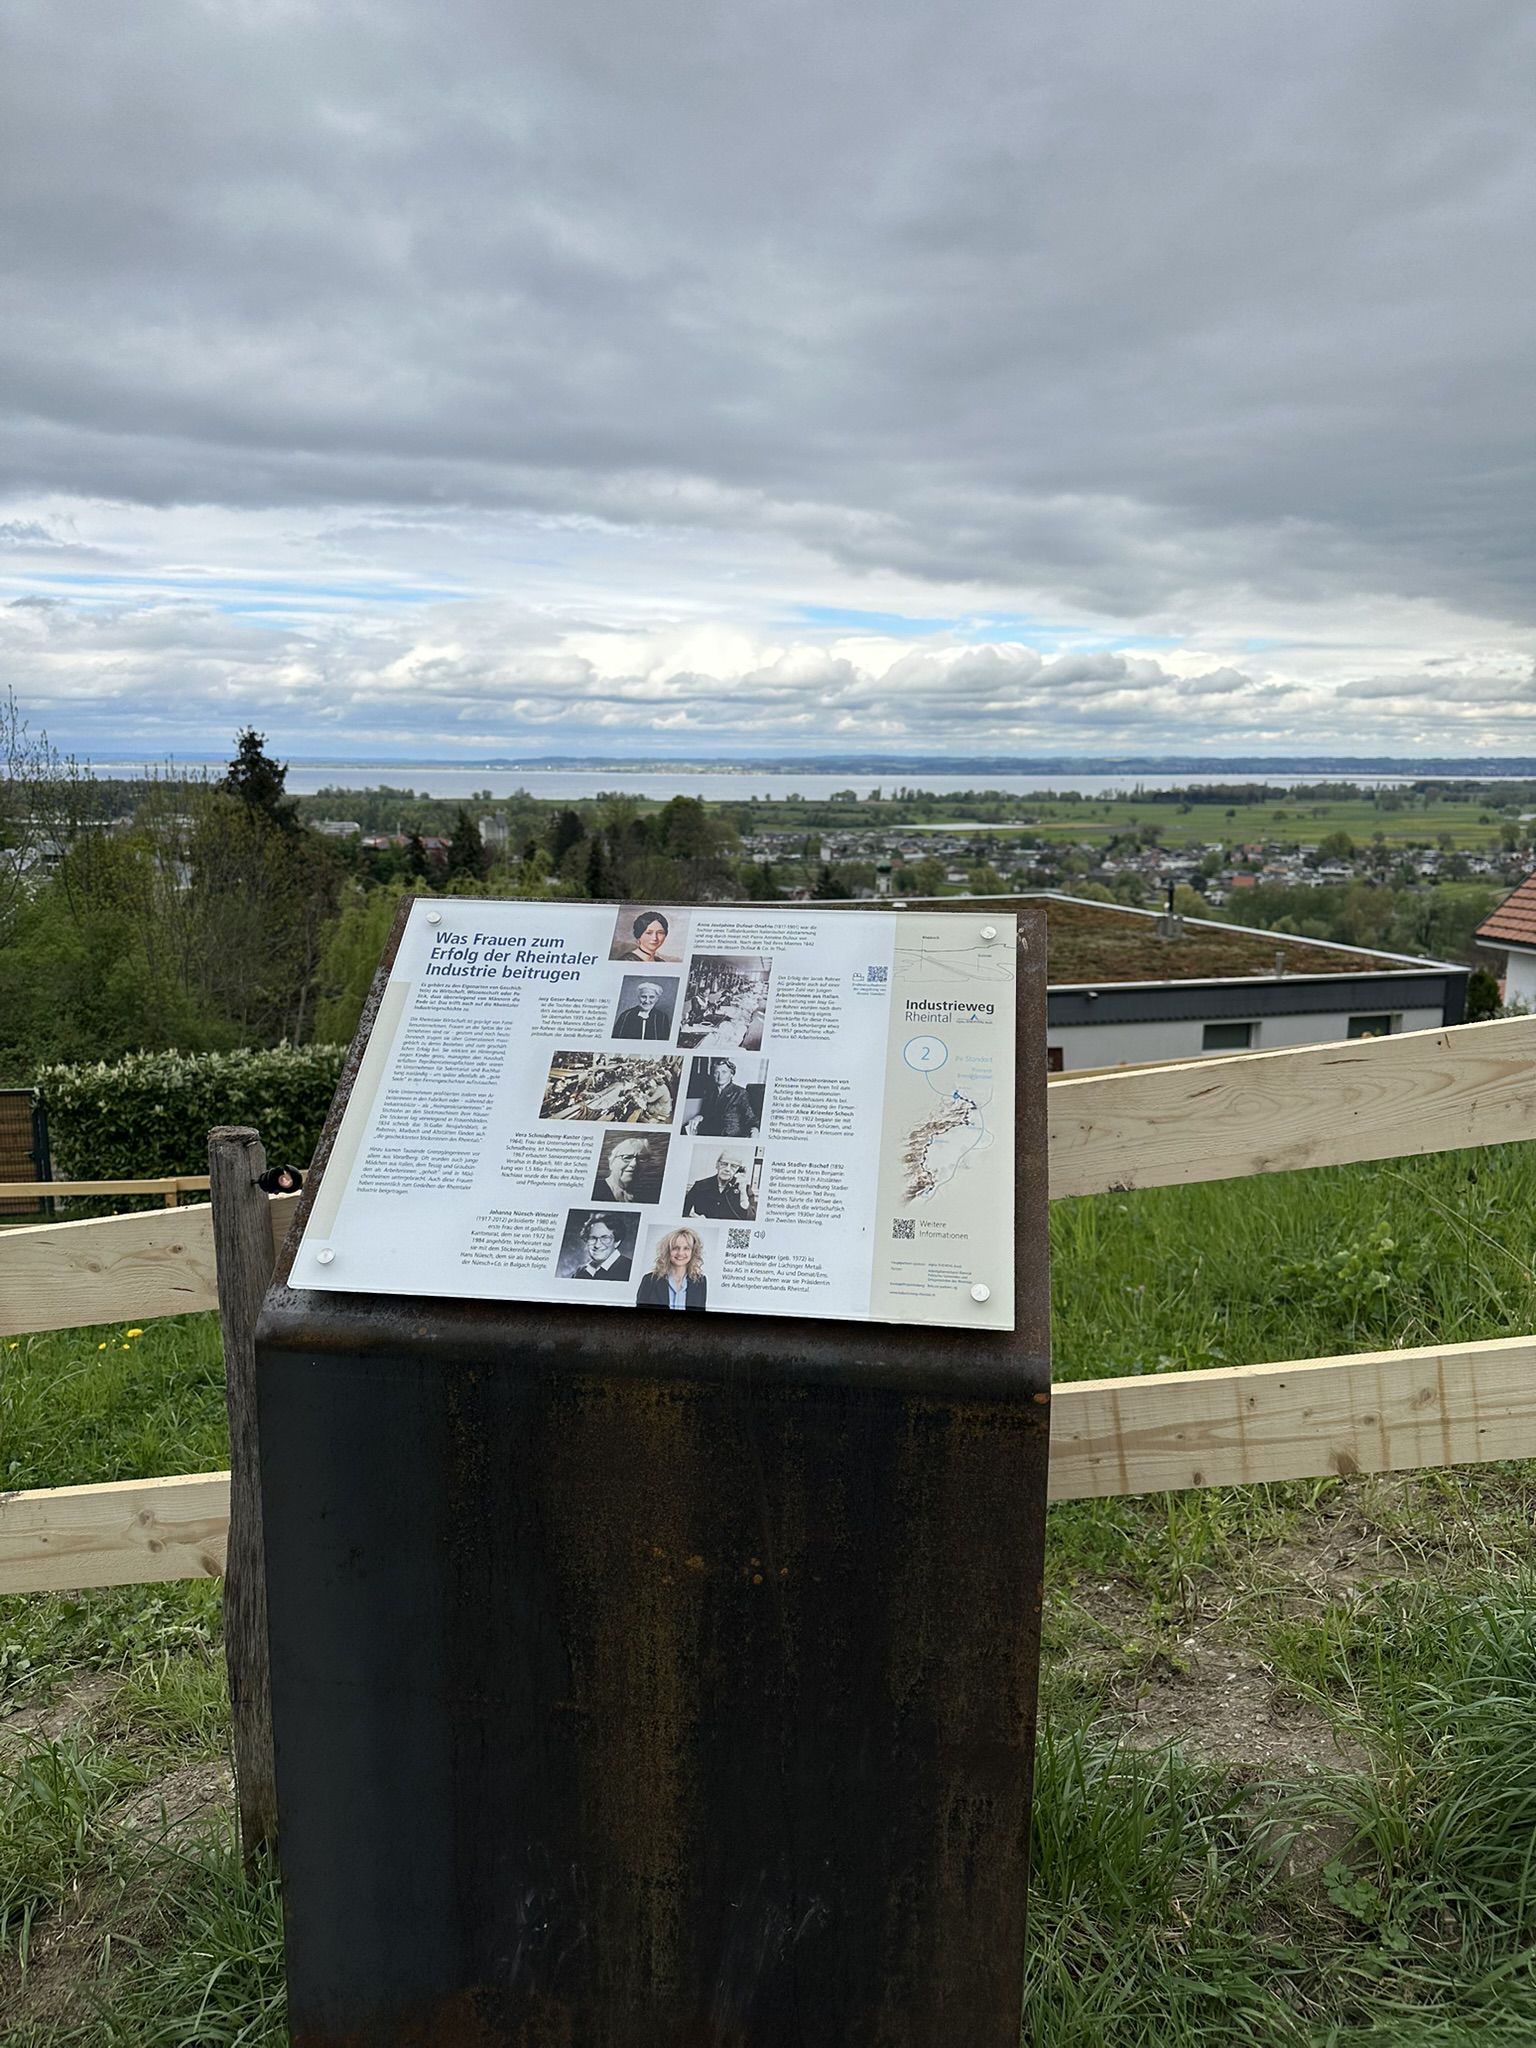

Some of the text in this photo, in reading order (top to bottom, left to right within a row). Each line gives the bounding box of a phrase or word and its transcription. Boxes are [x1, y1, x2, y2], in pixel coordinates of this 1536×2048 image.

[436, 932, 564, 948] Was Frauen zum
[430, 947, 598, 965] Erfolg der Rheintaler
[426, 962, 580, 983] Industrie beitrugen
[905, 999, 994, 1014] Industrieweg
[905, 1011, 952, 1023] Rheintal
[921, 1046, 930, 1060] 2
[920, 1220, 947, 1228] Weitere
[920, 1230, 968, 1240] Informationen
